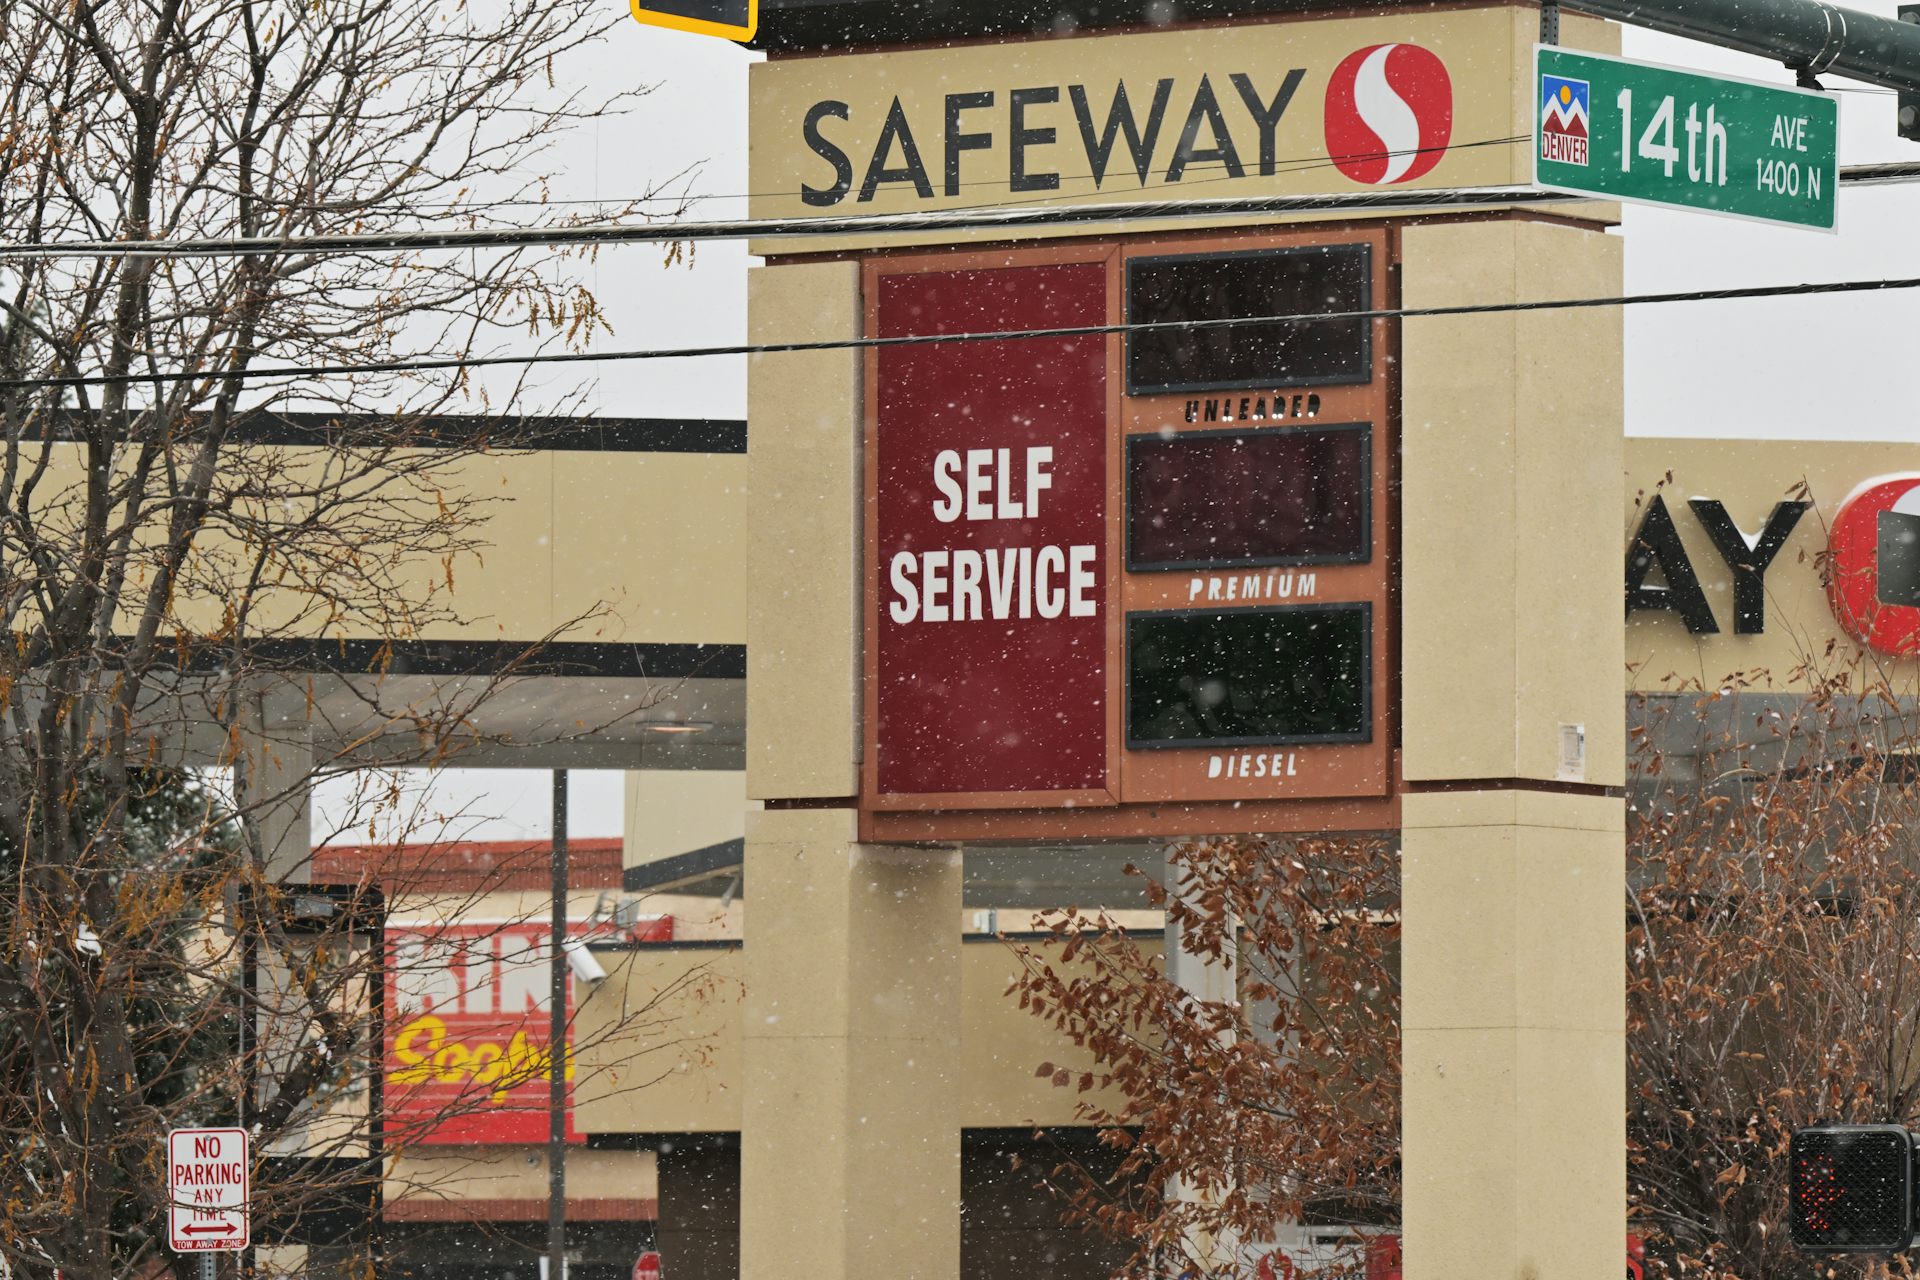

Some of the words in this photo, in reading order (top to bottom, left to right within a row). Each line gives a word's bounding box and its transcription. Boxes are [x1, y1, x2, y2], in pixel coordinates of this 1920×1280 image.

[800, 68, 1307, 206] SAFEWAY
[1617, 88, 1727, 187] 14th
[1771, 114, 1808, 152] AVE
[1542, 133, 1588, 165] DENVER
[1756, 158, 1800, 197] 1400
[1808, 166, 1821, 201] N
[1185, 394, 1321, 424] UNLEADED
[933, 446, 1053, 523] SELF
[889, 545, 1097, 624] SERVICE
[1189, 573, 1317, 601] PREMIUM
[1207, 753, 1298, 779] DIESEL
[195, 1136, 221, 1159] NO
[175, 1162, 242, 1186] PARKING
[194, 1188, 224, 1204] ANY
[193, 1206, 227, 1222] TIME
[176, 1240, 193, 1249] TOW
[195, 1239, 218, 1249] AWAY
[221, 1239, 243, 1249] ZONE
